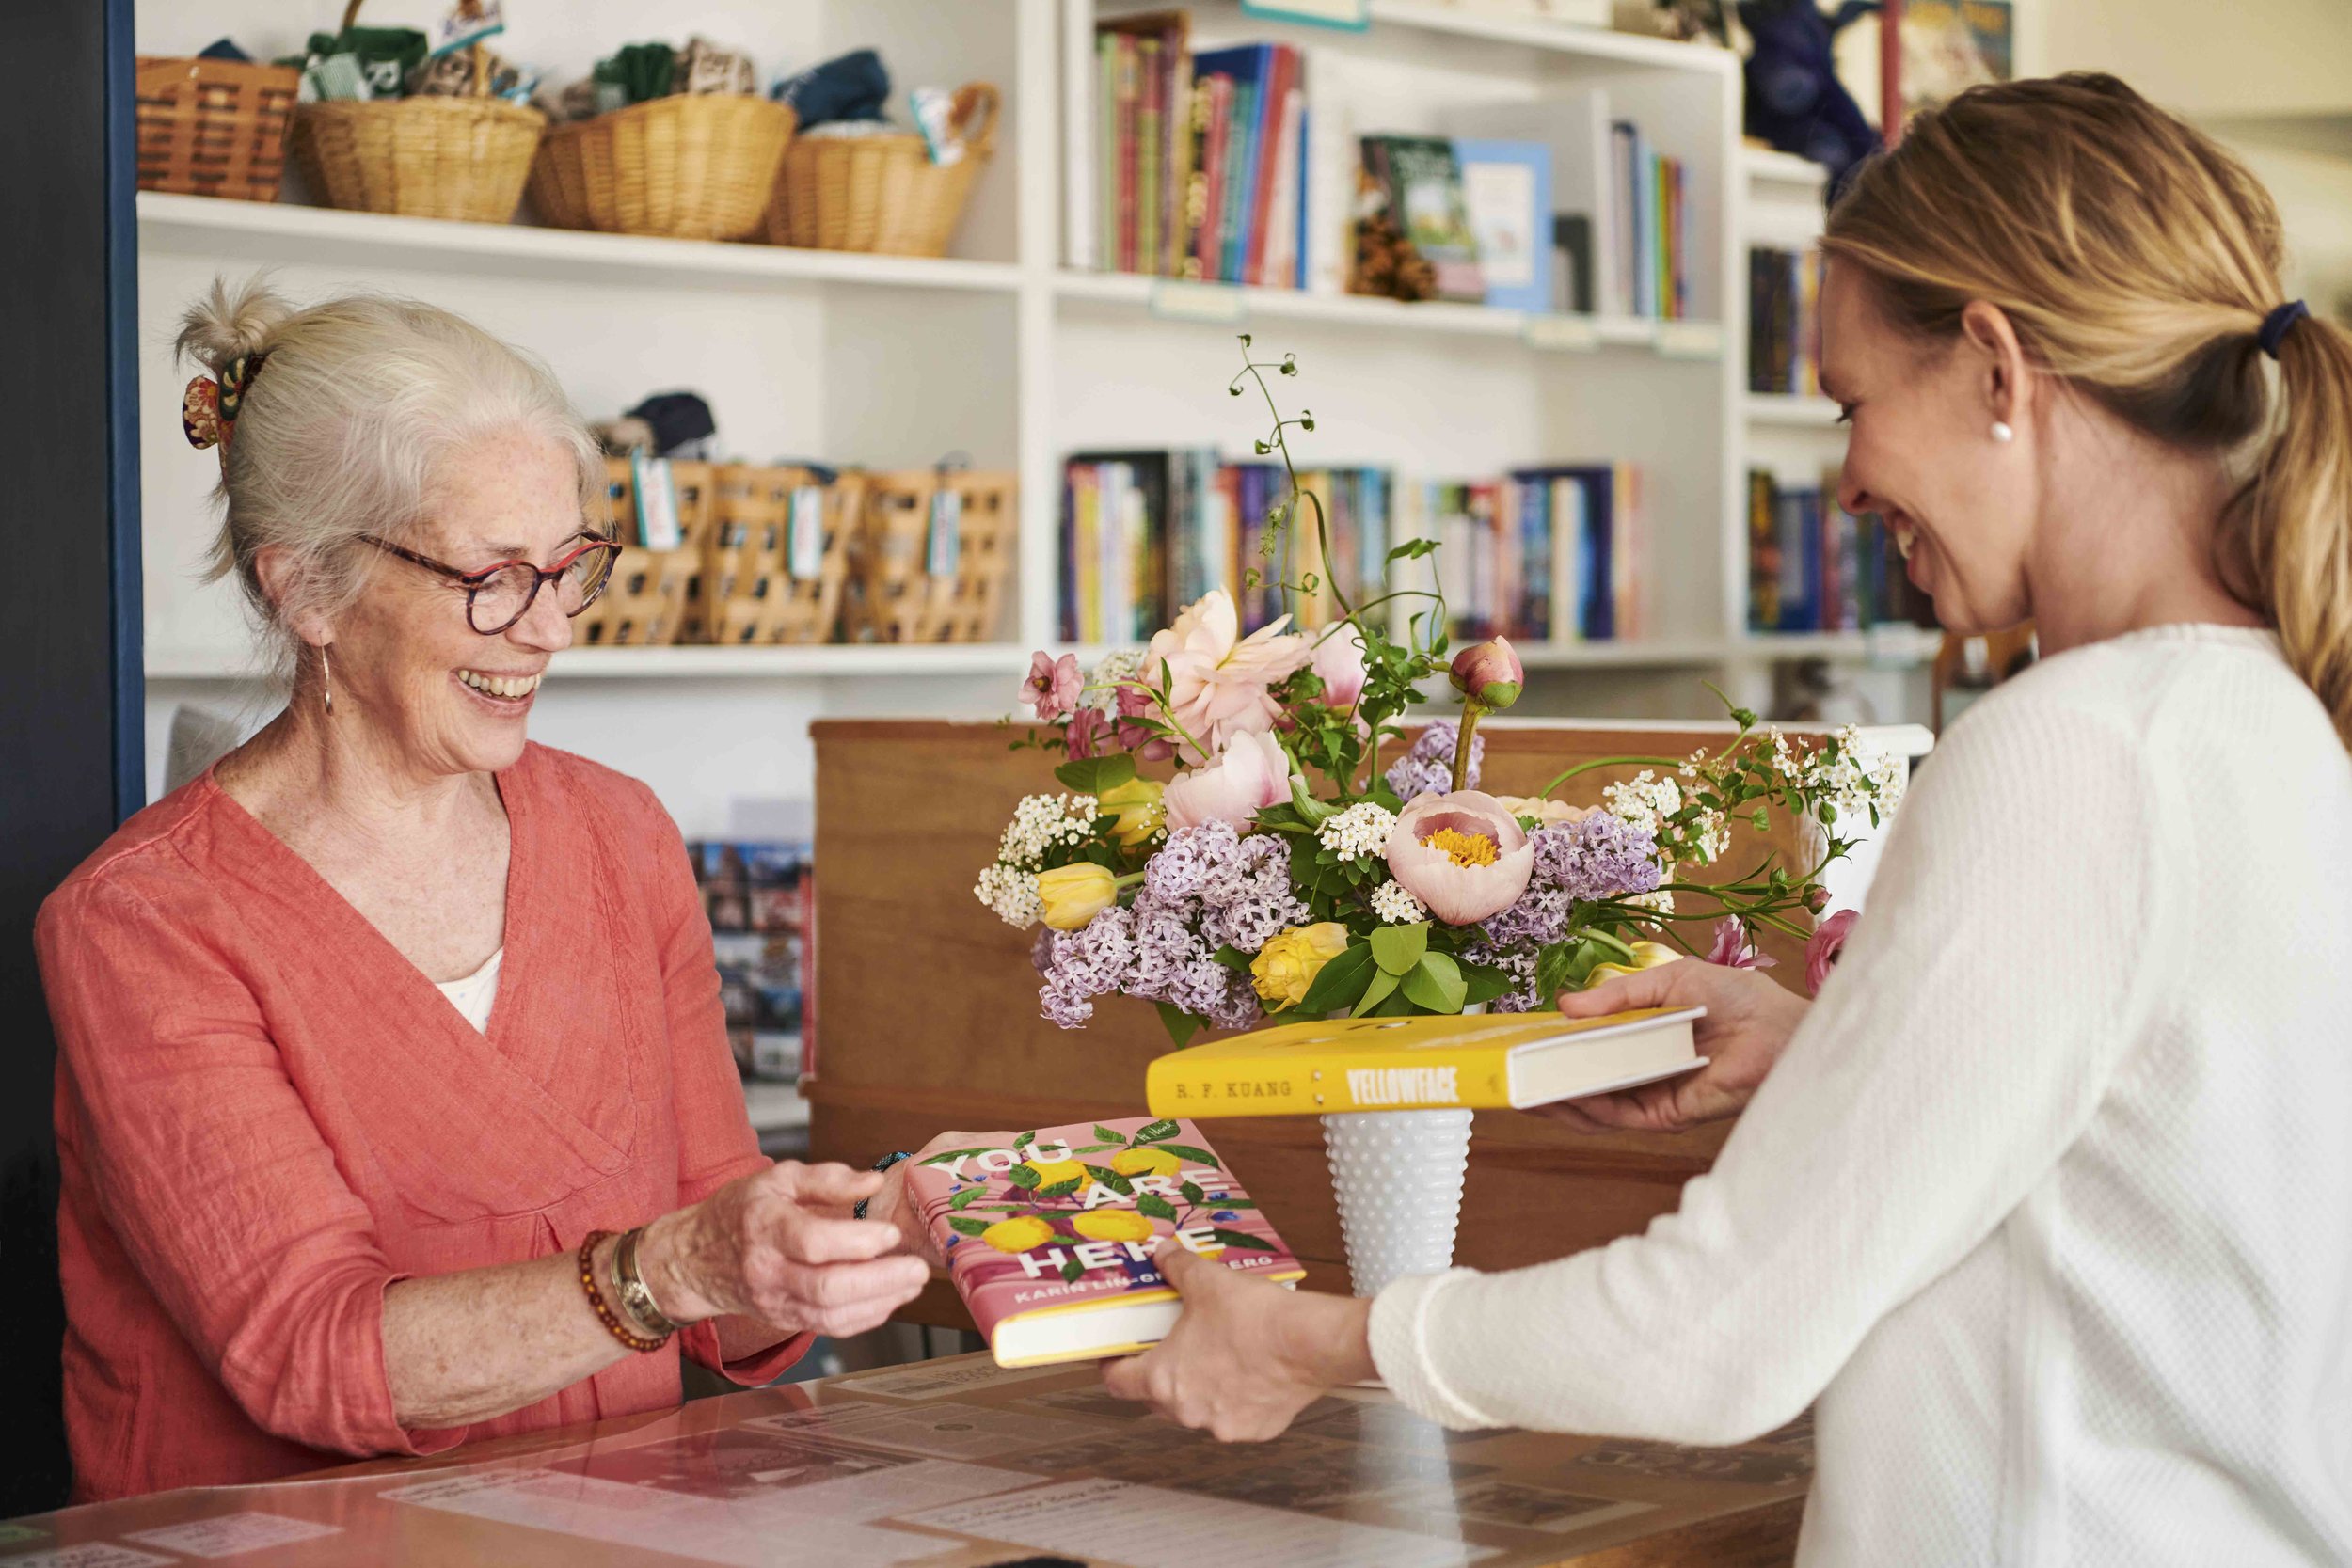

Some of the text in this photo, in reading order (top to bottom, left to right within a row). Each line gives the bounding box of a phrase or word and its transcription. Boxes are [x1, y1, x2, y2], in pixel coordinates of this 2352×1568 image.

[1176, 1066, 1460, 1105] R. F. KUANG YELLOWFACE
[928, 1138, 1073, 1180] YOU
[1083, 1168, 1230, 1210] ARE
[1014, 1282, 1087, 1304] KARIN
